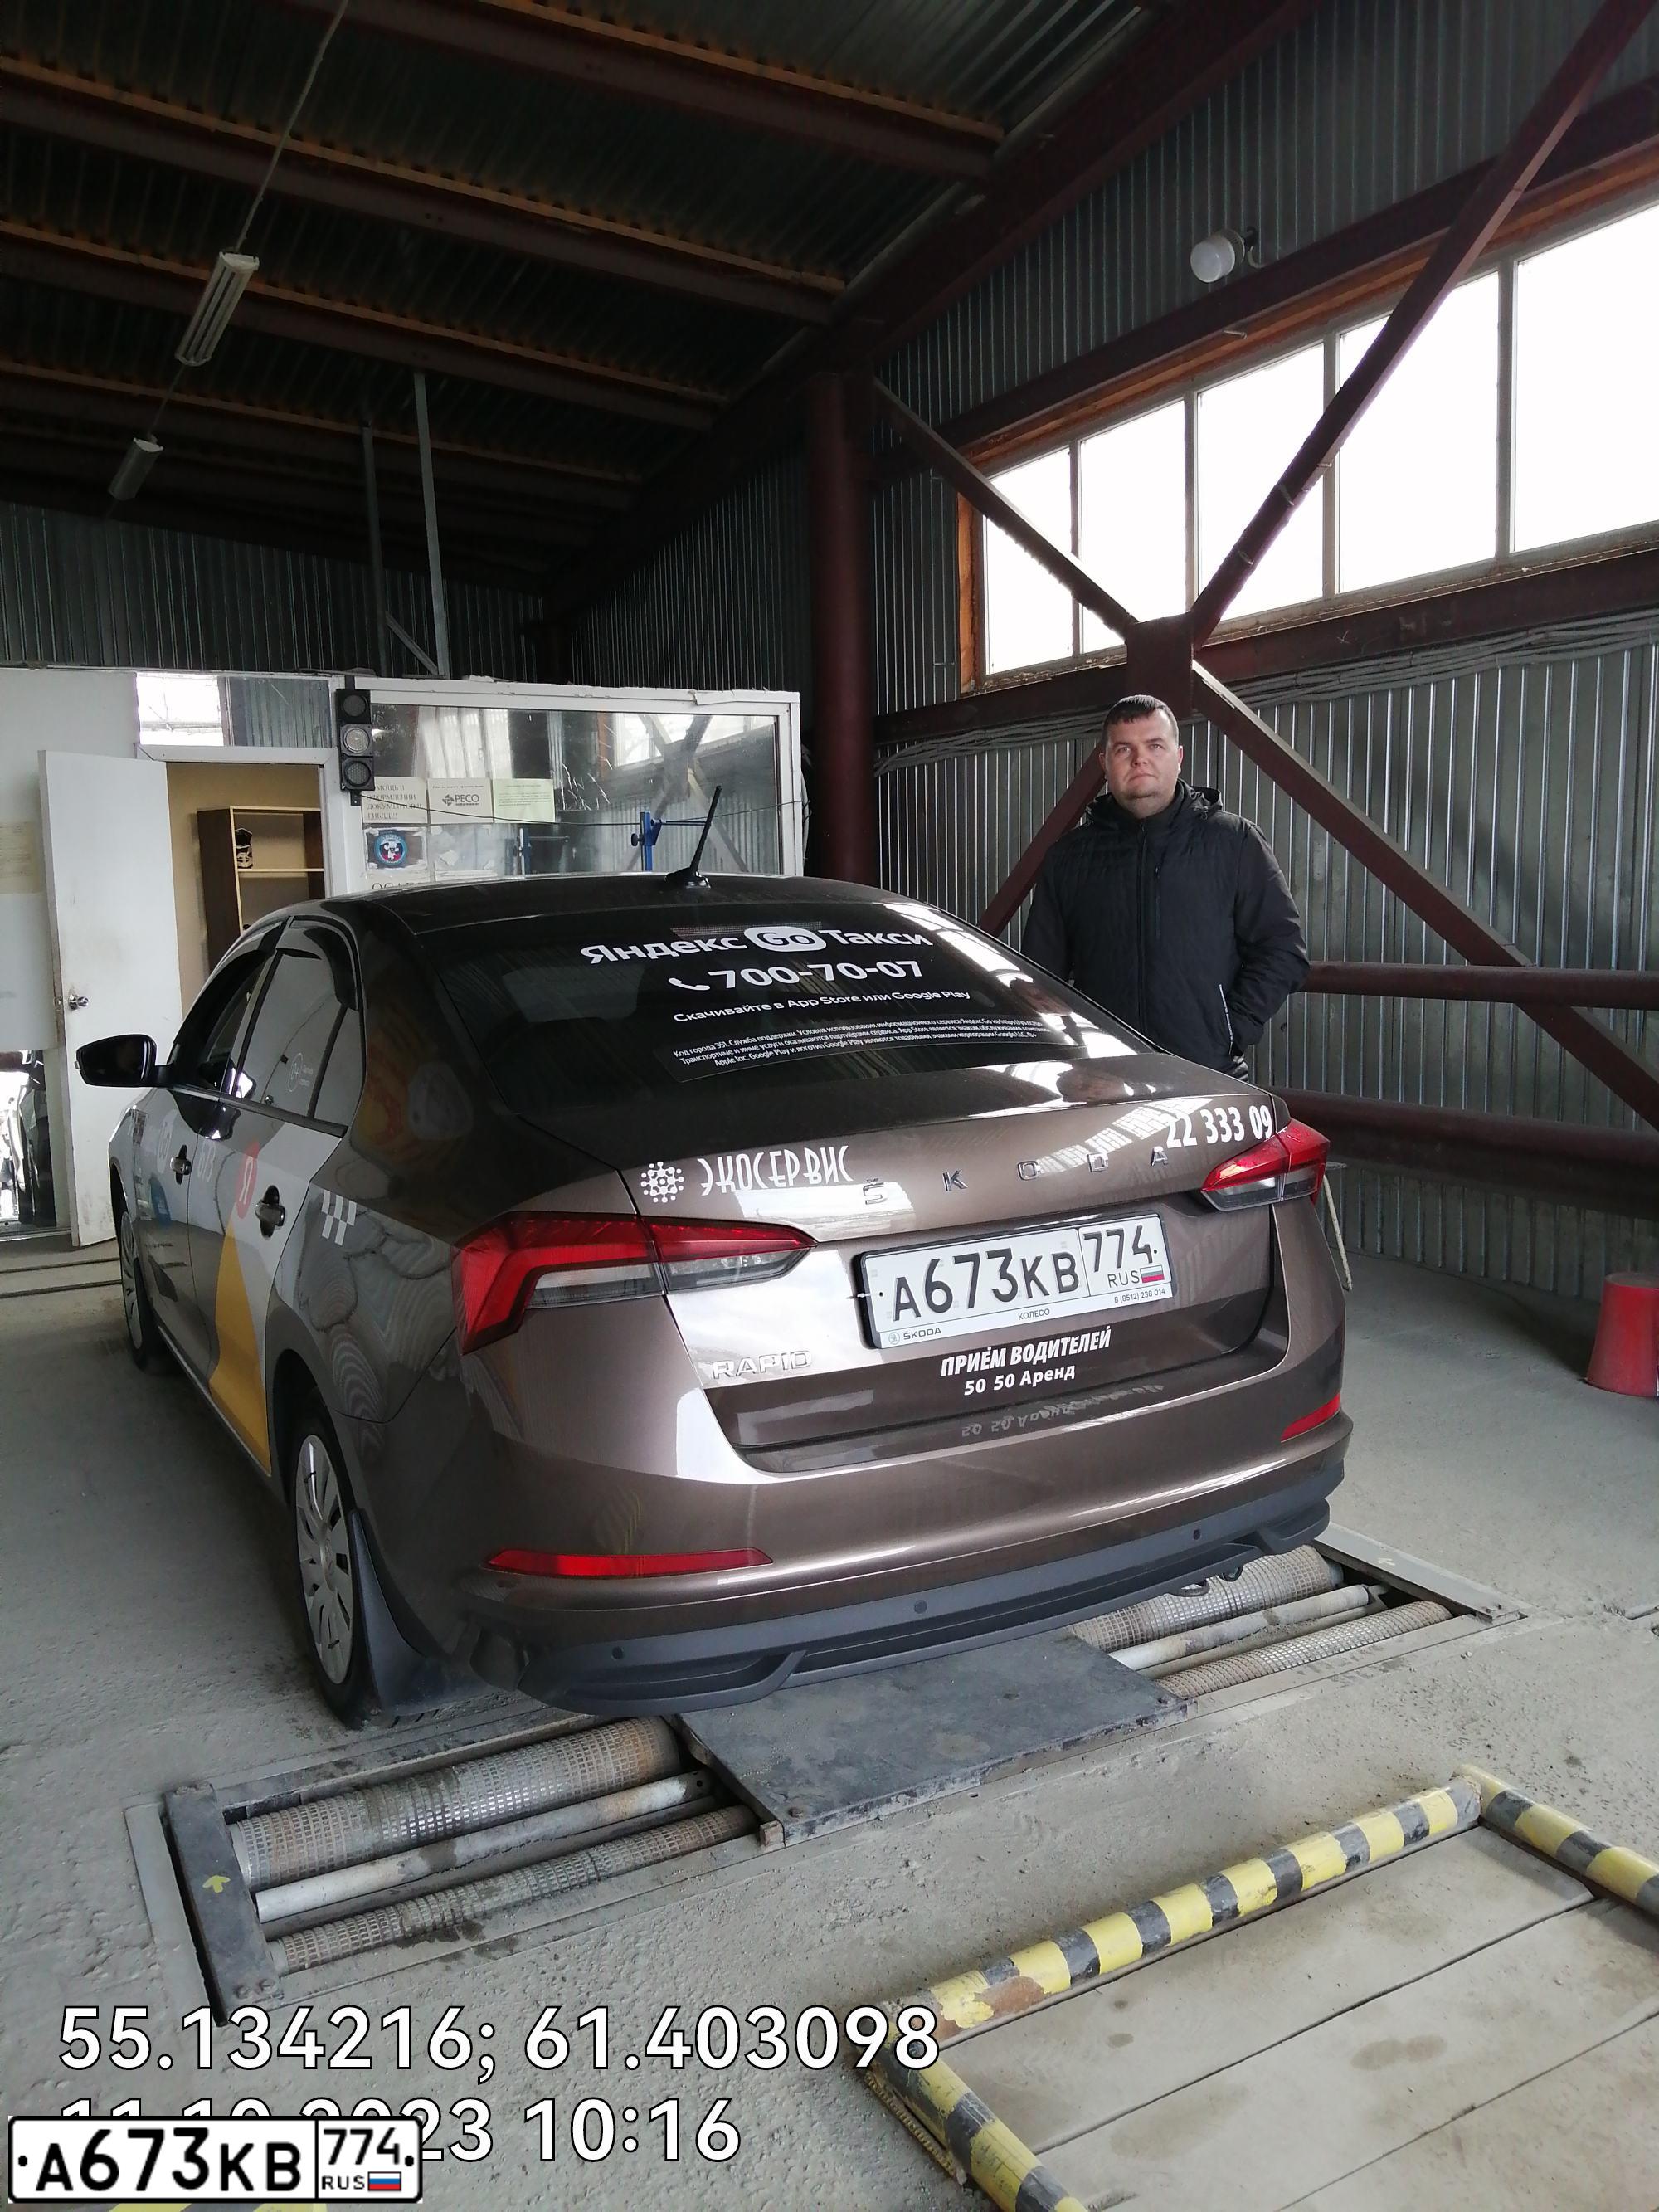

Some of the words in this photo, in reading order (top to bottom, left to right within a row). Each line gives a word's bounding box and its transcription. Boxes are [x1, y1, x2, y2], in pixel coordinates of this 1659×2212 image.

[581, 937, 747, 964] Яндекс
[757, 931, 816, 947] Go
[818, 929, 933, 946] Такси
[708, 960, 923, 988] 700-70-07
[673, 1002, 772, 1023] Скачивайте
[787, 998, 819, 1008] App
[821, 995, 862, 1005] Store
[891, 991, 941, 1000] Google
[942, 990, 971, 999] Play
[679, 1050, 734, 1065] Транспортные
[740, 1045, 761, 1054] иные
[760, 1040, 785, 1051] услуги
[689, 1045, 716, 1055] города
[728, 1036, 757, 1047] Служба
[714, 1058, 736, 1067] Apple
[748, 1050, 775, 1060] Google
[773, 1047, 791, 1056] Play
[795, 1043, 825, 1053] логотип
[824, 1040, 849, 1049] Google
[848, 1038, 864, 1046] Play
[1165, 1113, 1198, 1148] 22
[1201, 1108, 1245, 1143] 333
[1248, 1104, 1273, 1140] 09
[697, 1145, 854, 1196] ЭКОСЕРВИС
[862, 1145, 1170, 1206] ŠKODA
[1083, 1225, 1153, 1273] 774
[1107, 1270, 1140, 1289] RUS
[1119, 1292, 1141, 1304] (8512)
[1141, 1290, 1154, 1299] 238
[1154, 1288, 1166, 1297] 014
[1018, 1308, 1051, 1320] КОЛЕСО
[903, 1327, 942, 1340] ŠKODA
[1010, 1325, 1112, 1366] ВОДИТЕЛЕЙ
[712, 1350, 812, 1379] RAPID
[964, 1378, 986, 1396] 50
[993, 1373, 1015, 1391] 50
[1019, 1365, 1077, 1387] Аренд
